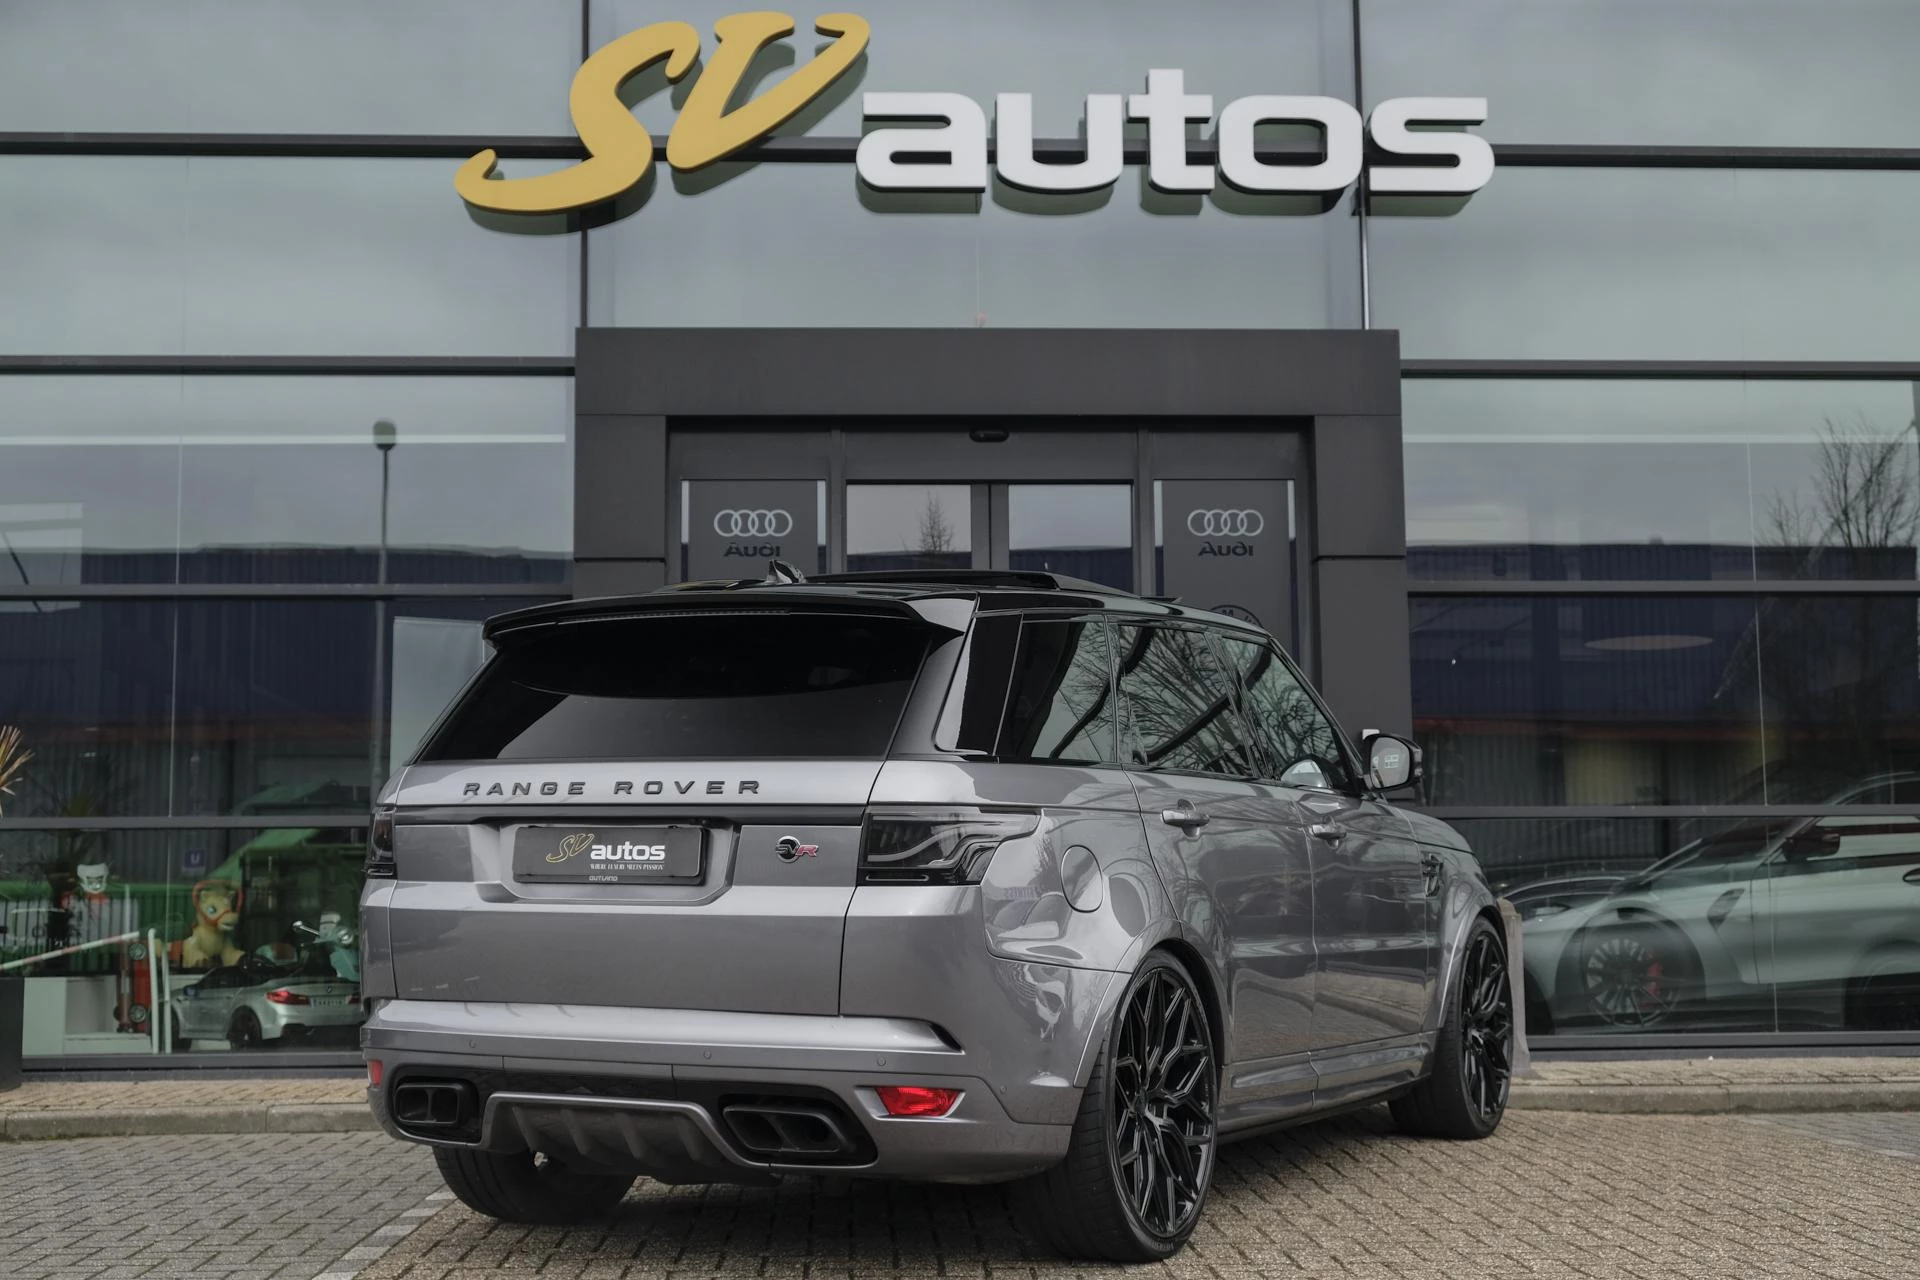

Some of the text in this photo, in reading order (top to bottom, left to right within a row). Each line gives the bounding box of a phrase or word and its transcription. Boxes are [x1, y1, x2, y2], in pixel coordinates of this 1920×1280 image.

[453, 11, 1495, 216] SV autos
[723, 542, 781, 557] Audi
[1198, 541, 1254, 557] Audi
[462, 780, 760, 796] RANGE ROVER
[545, 832, 666, 863] SV autos
